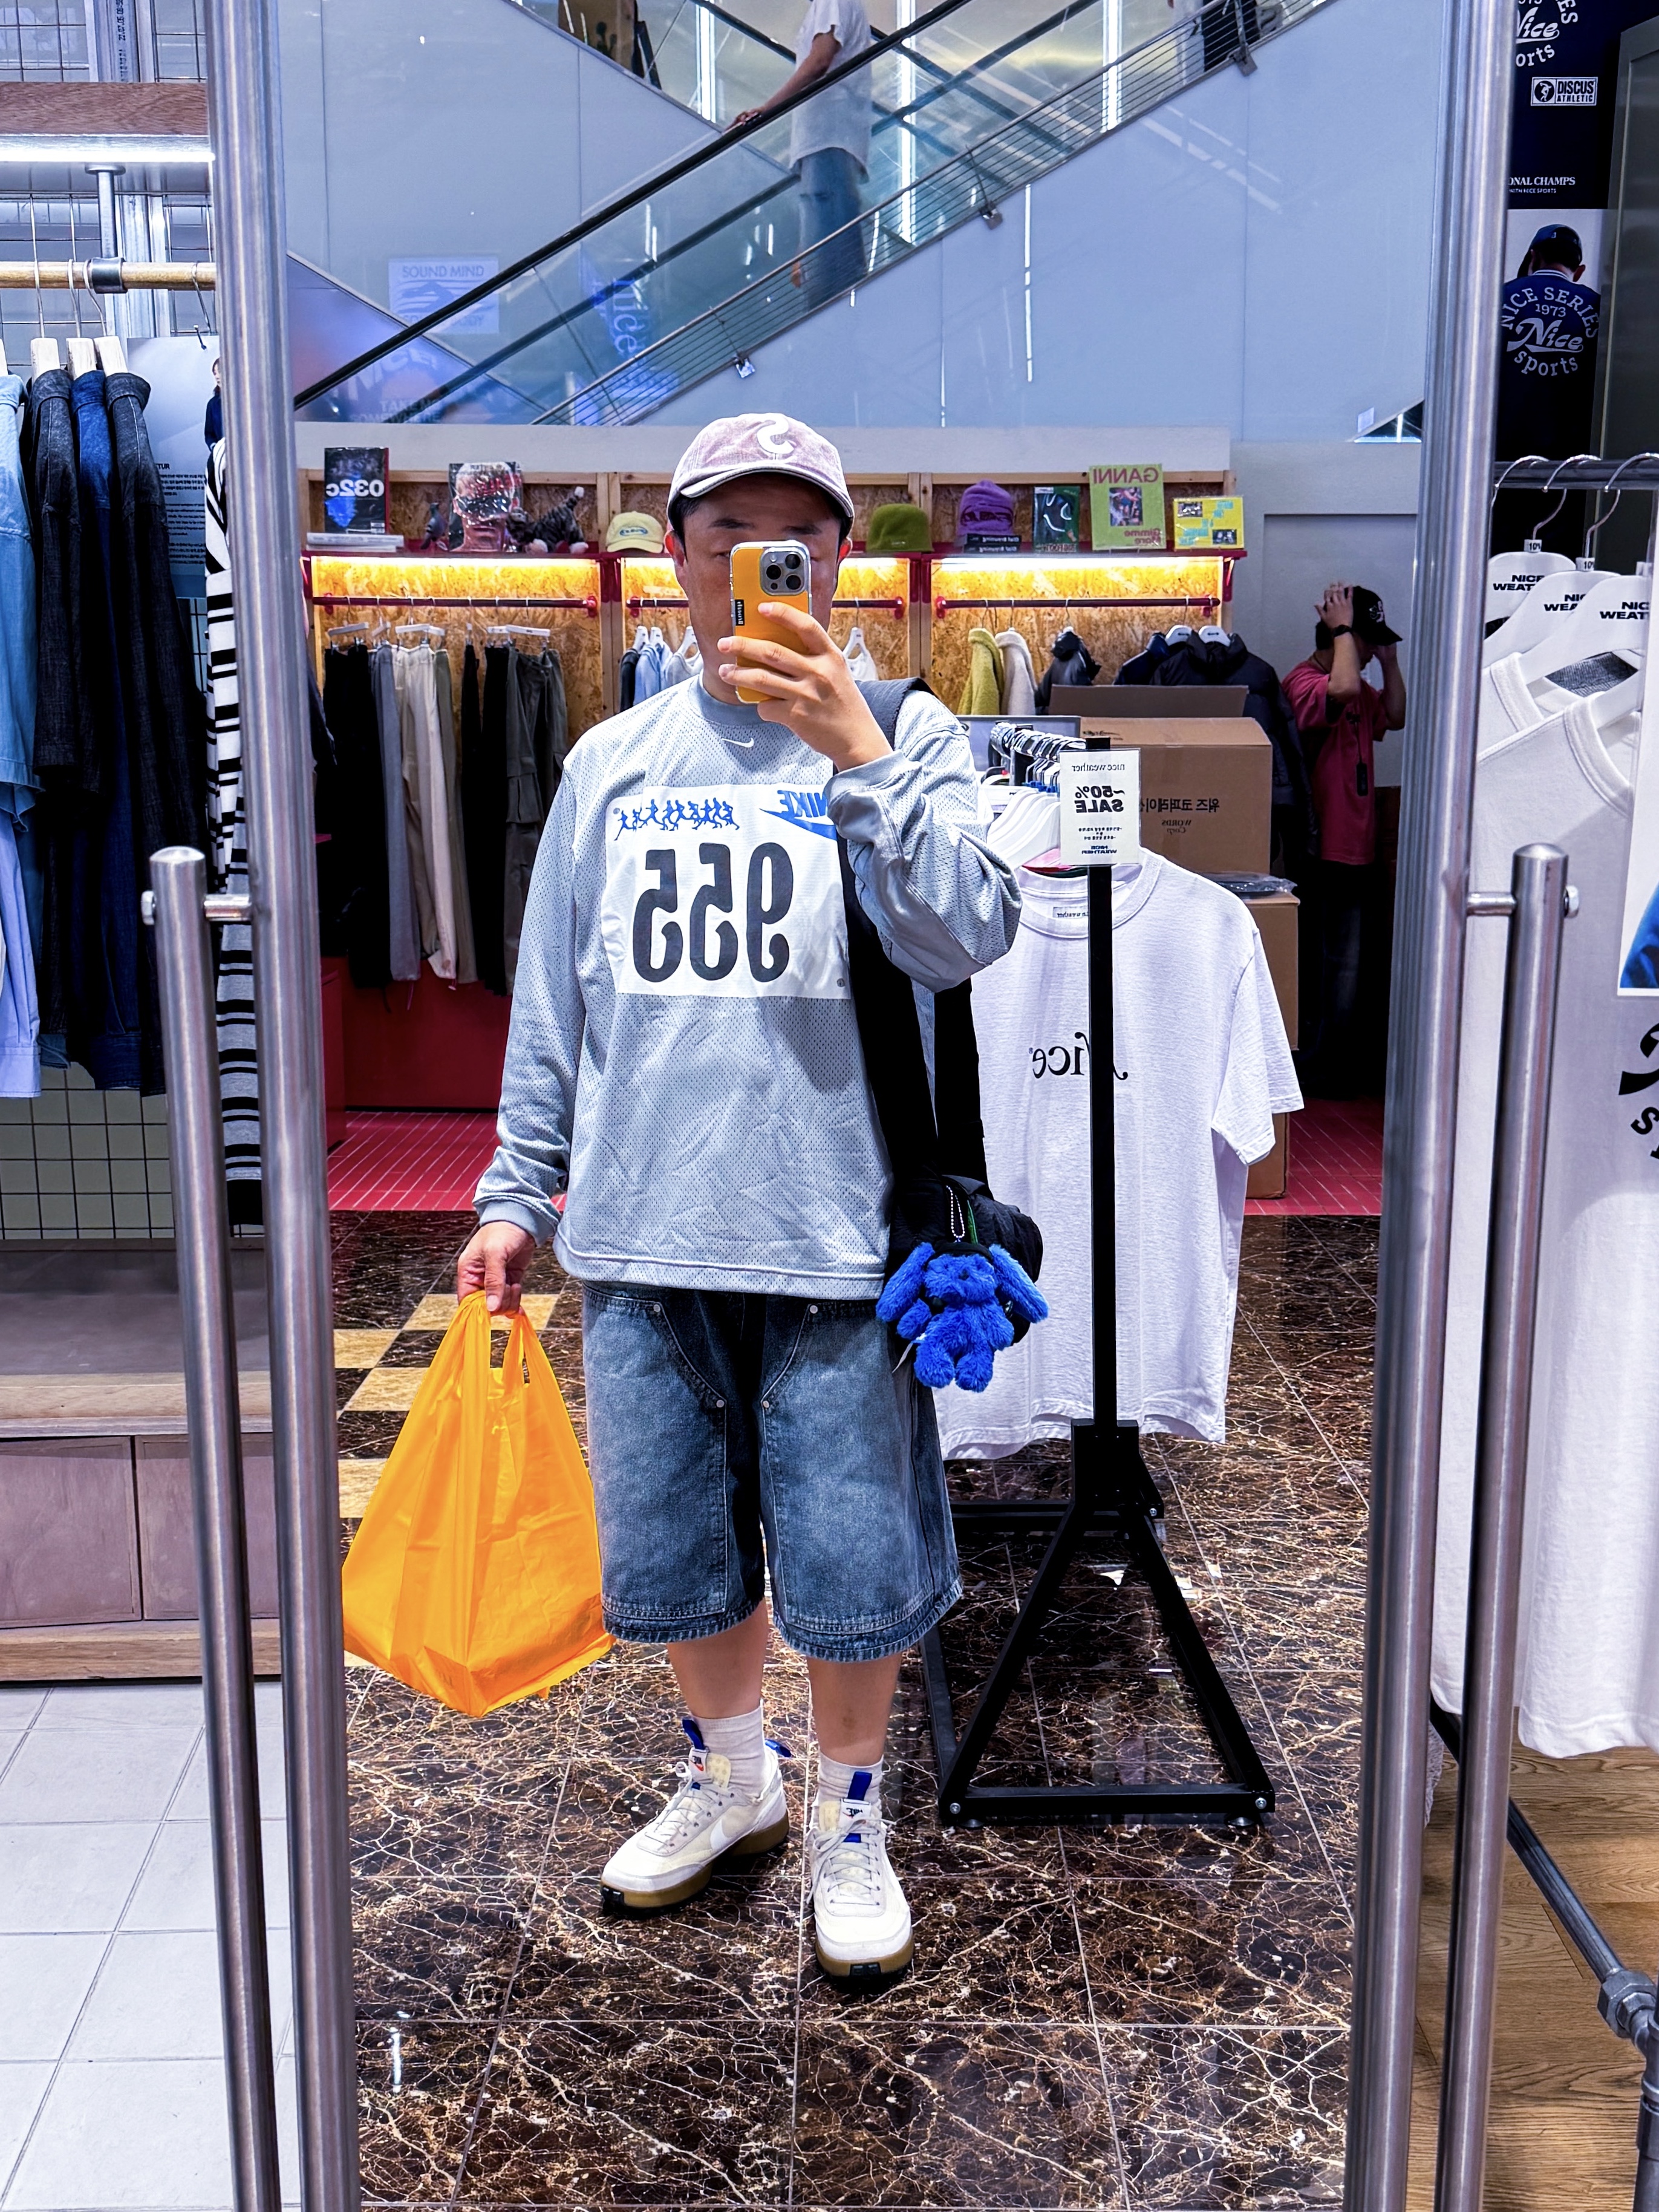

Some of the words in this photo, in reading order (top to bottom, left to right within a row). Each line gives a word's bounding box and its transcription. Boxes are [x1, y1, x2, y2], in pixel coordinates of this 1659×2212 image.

[1516, 45, 1555, 67] orts
[1557, 80, 1594, 95] DISCUS
[1534, 177, 1576, 186] CHAMPS
[402, 266, 447, 278] SOUND
[450, 265, 484, 277] MIND
[1500, 288, 1538, 330] NICE
[1544, 287, 1599, 338] SERIES
[1535, 304, 1566, 318] 1973
[1506, 318, 1583, 353] Nice
[1514, 350, 1578, 377] sports
[1622, 601, 1649, 610] NIC
[1599, 611, 1649, 620] WEAT
